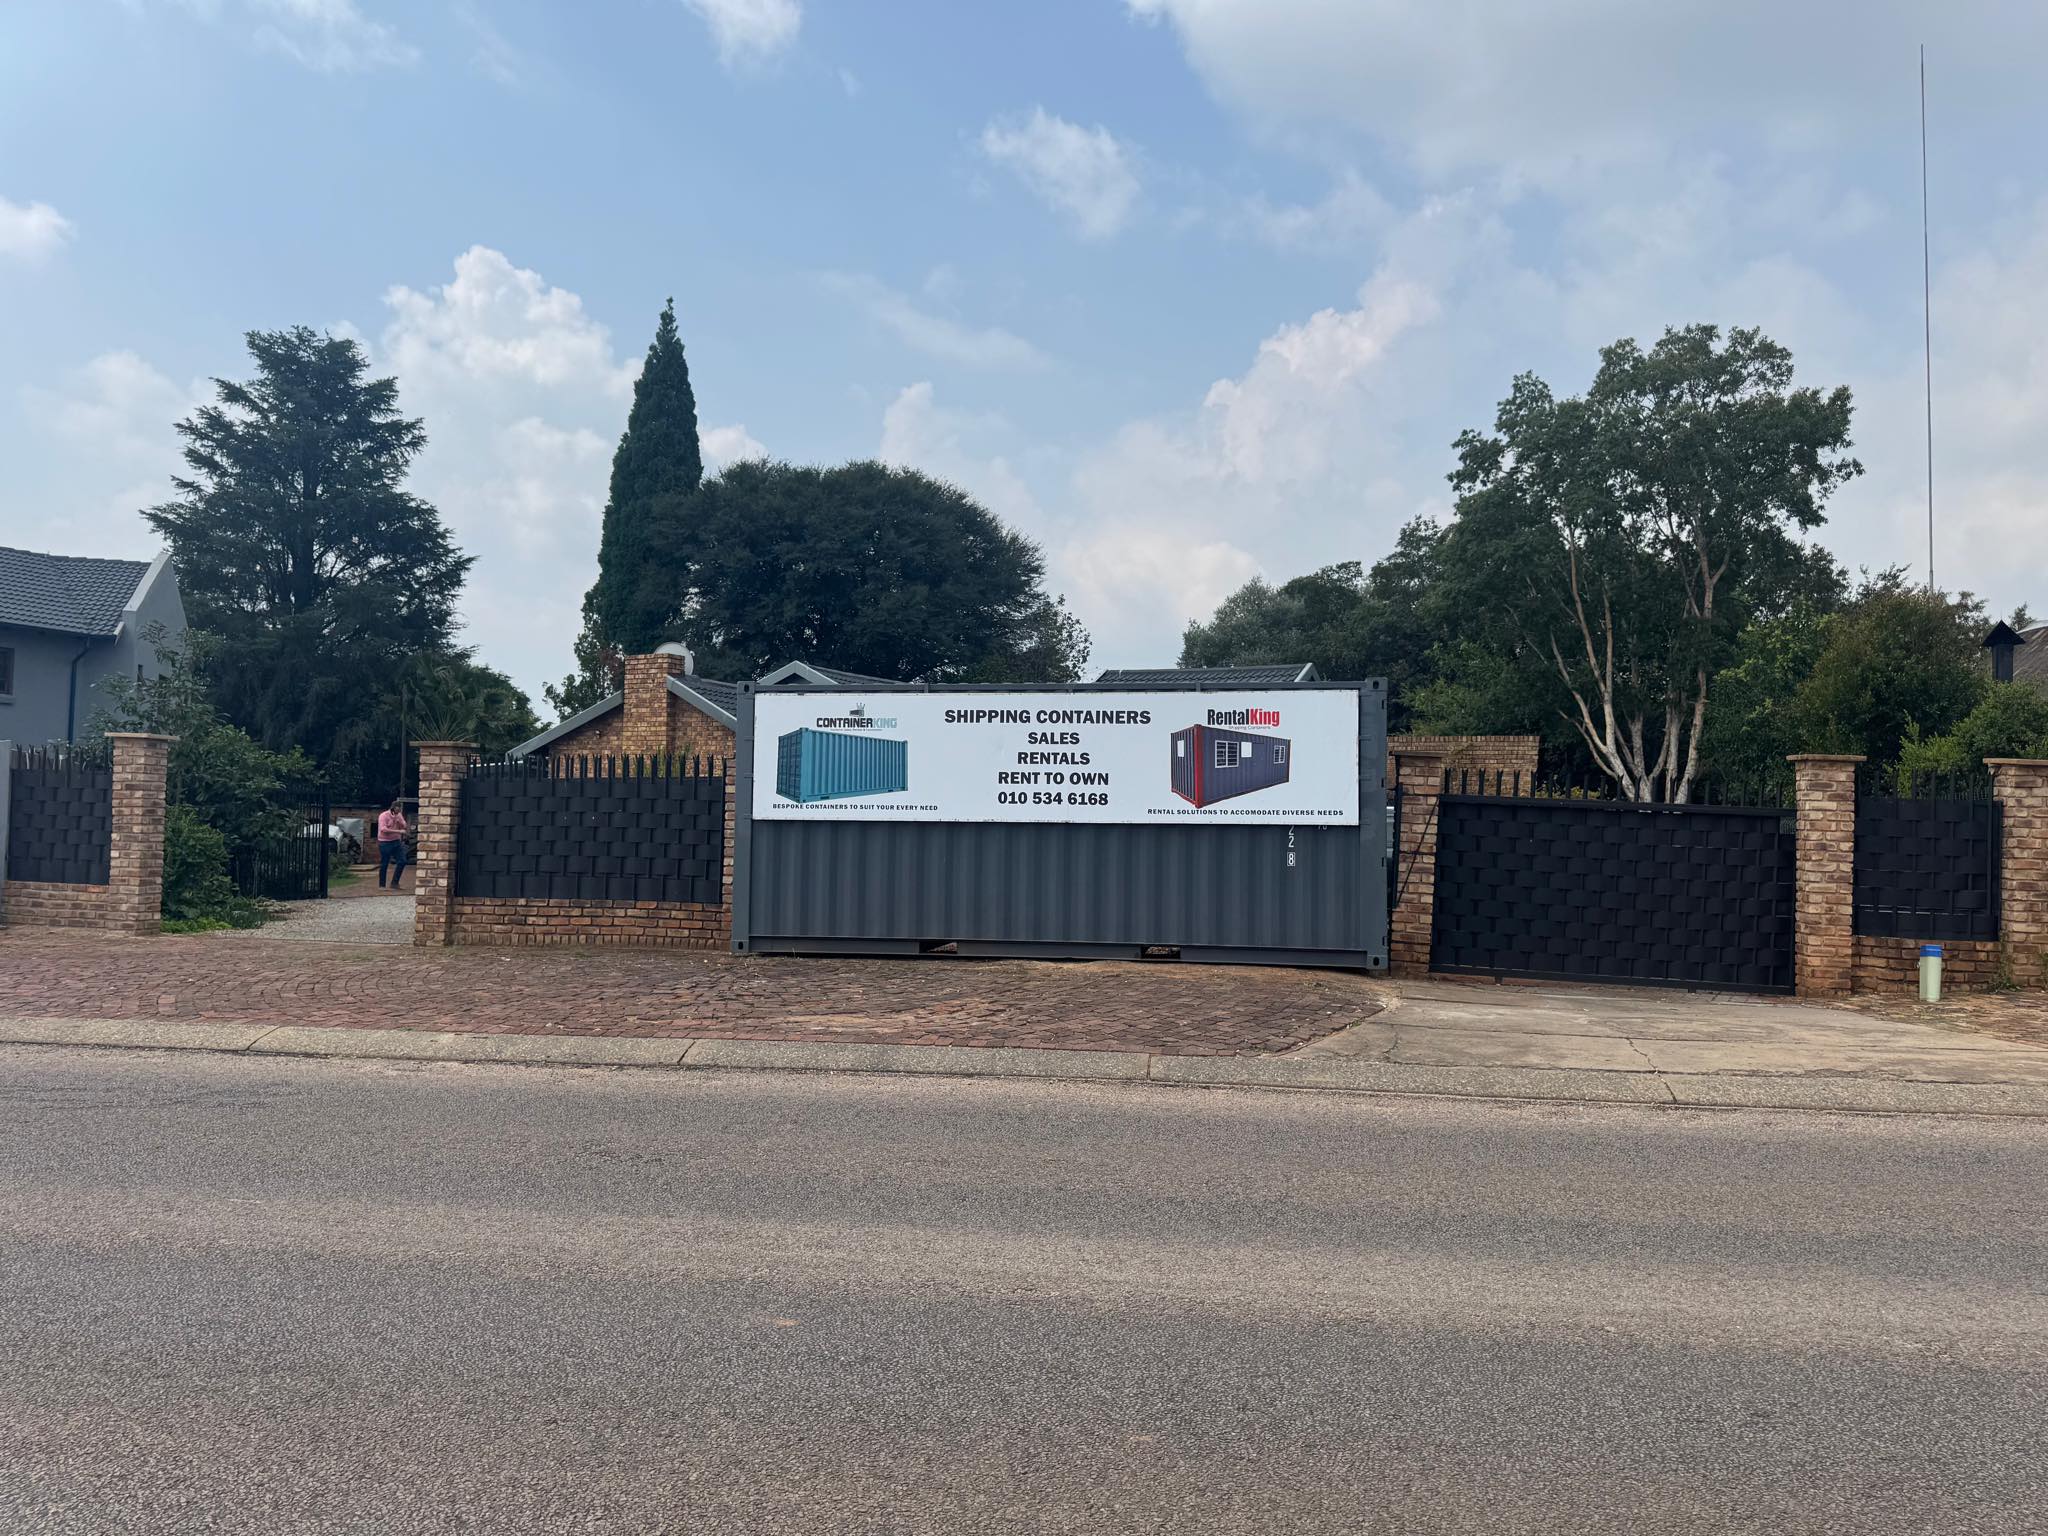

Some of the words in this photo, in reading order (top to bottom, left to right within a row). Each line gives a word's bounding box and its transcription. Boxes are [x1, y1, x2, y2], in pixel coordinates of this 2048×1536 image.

[816, 717, 898, 728] CONTAINERKING
[944, 709, 1031, 724] SHIPPING
[1036, 710, 1151, 725] CONTAINERS
[1207, 708, 1280, 727] RentalKing
[1027, 732, 1080, 745] SALES
[1017, 752, 1090, 765] RENTALS
[998, 771, 1040, 785] RENT
[1044, 772, 1065, 785] TO
[1069, 772, 1109, 786] OWN
[997, 791, 1028, 805] 010
[1032, 792, 1063, 805] 534
[1067, 792, 1109, 806] 6168
